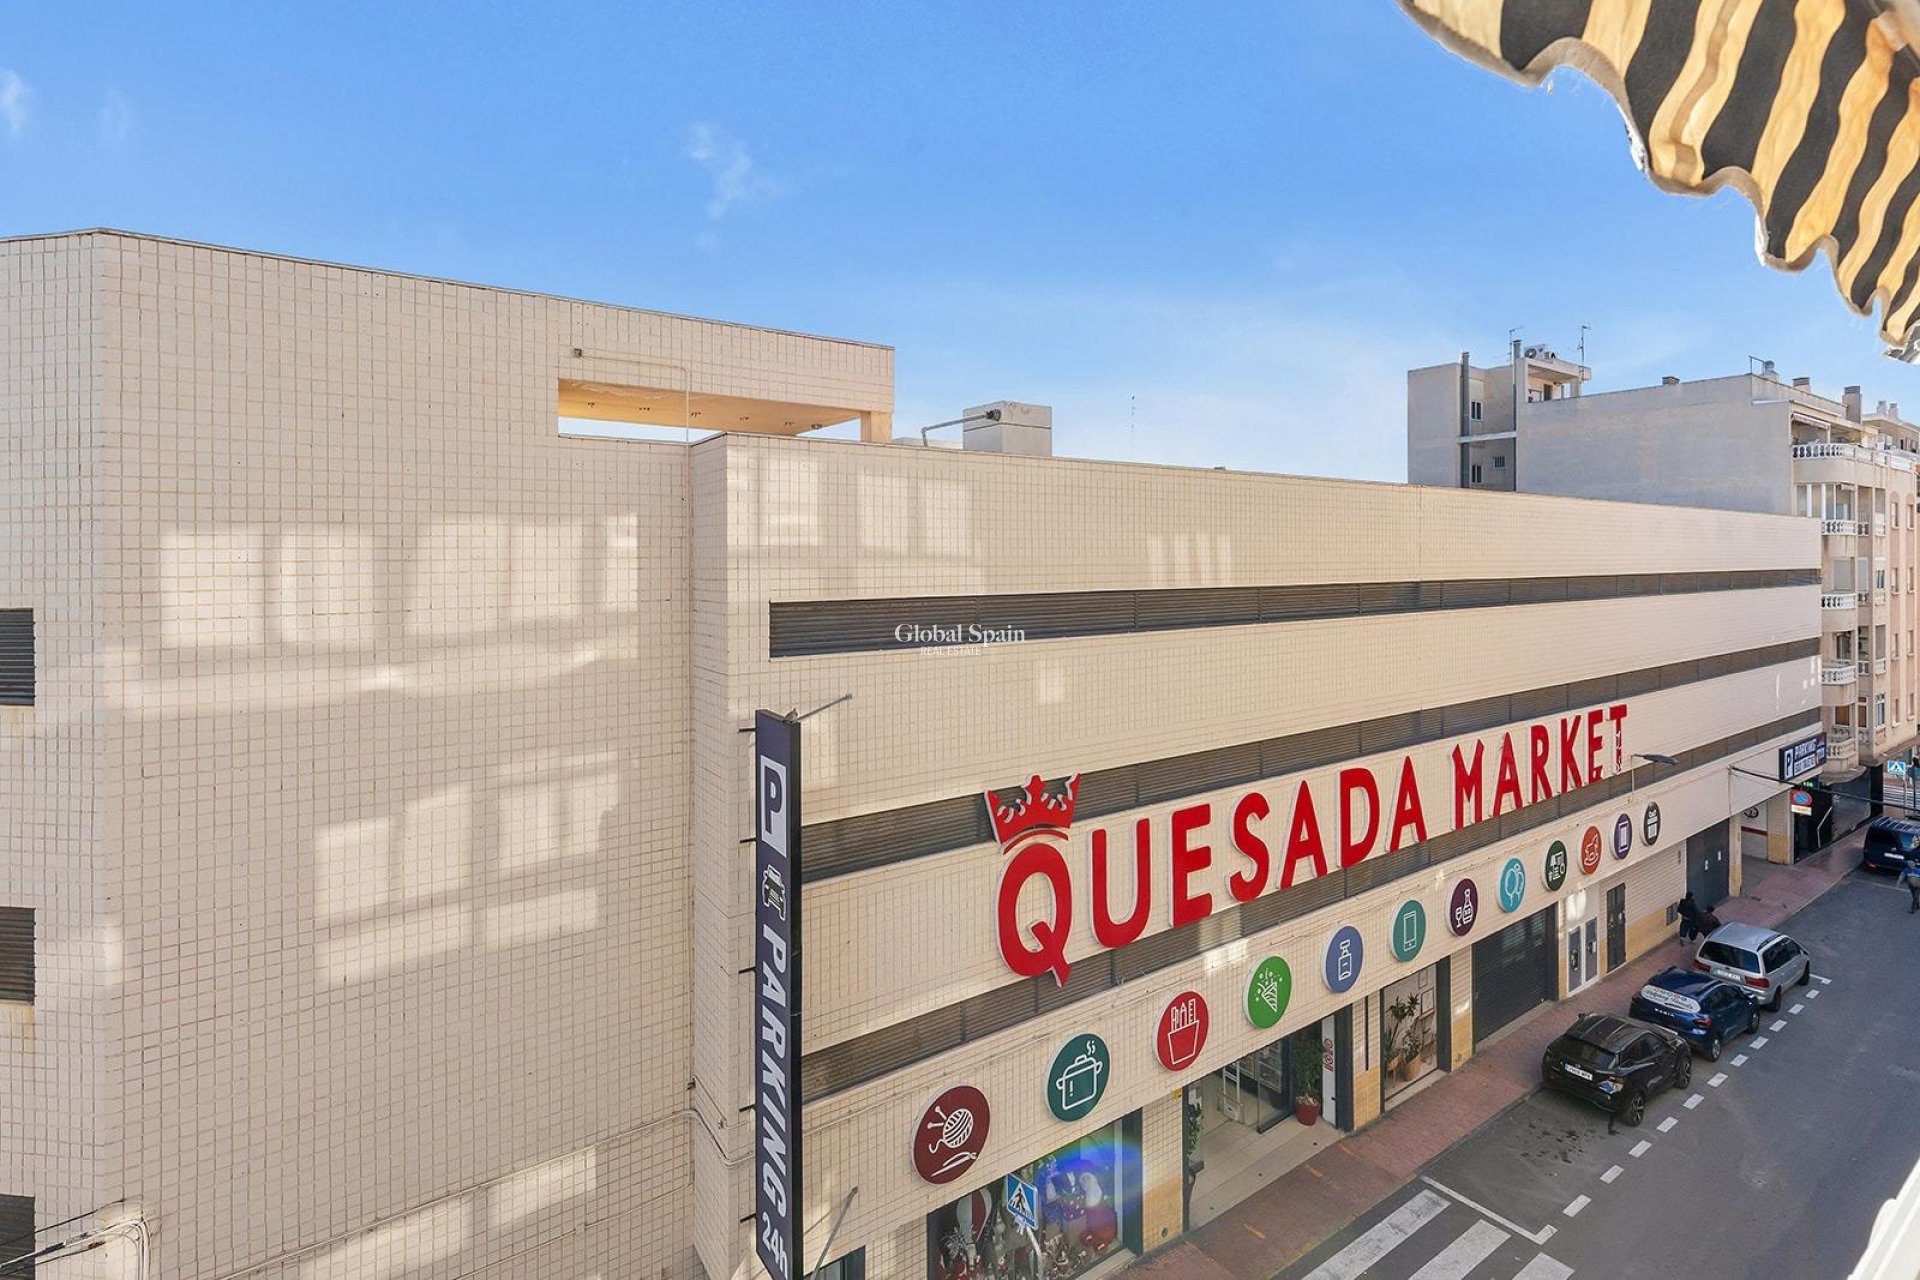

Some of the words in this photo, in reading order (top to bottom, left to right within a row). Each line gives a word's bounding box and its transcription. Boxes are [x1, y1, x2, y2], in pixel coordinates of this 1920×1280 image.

[763, 763, 784, 838] P
[997, 755, 1428, 987] QUESADA
[1451, 704, 1627, 831] MARKET
[762, 923, 787, 1219] PARKING
[762, 1211, 788, 1280] 24h
